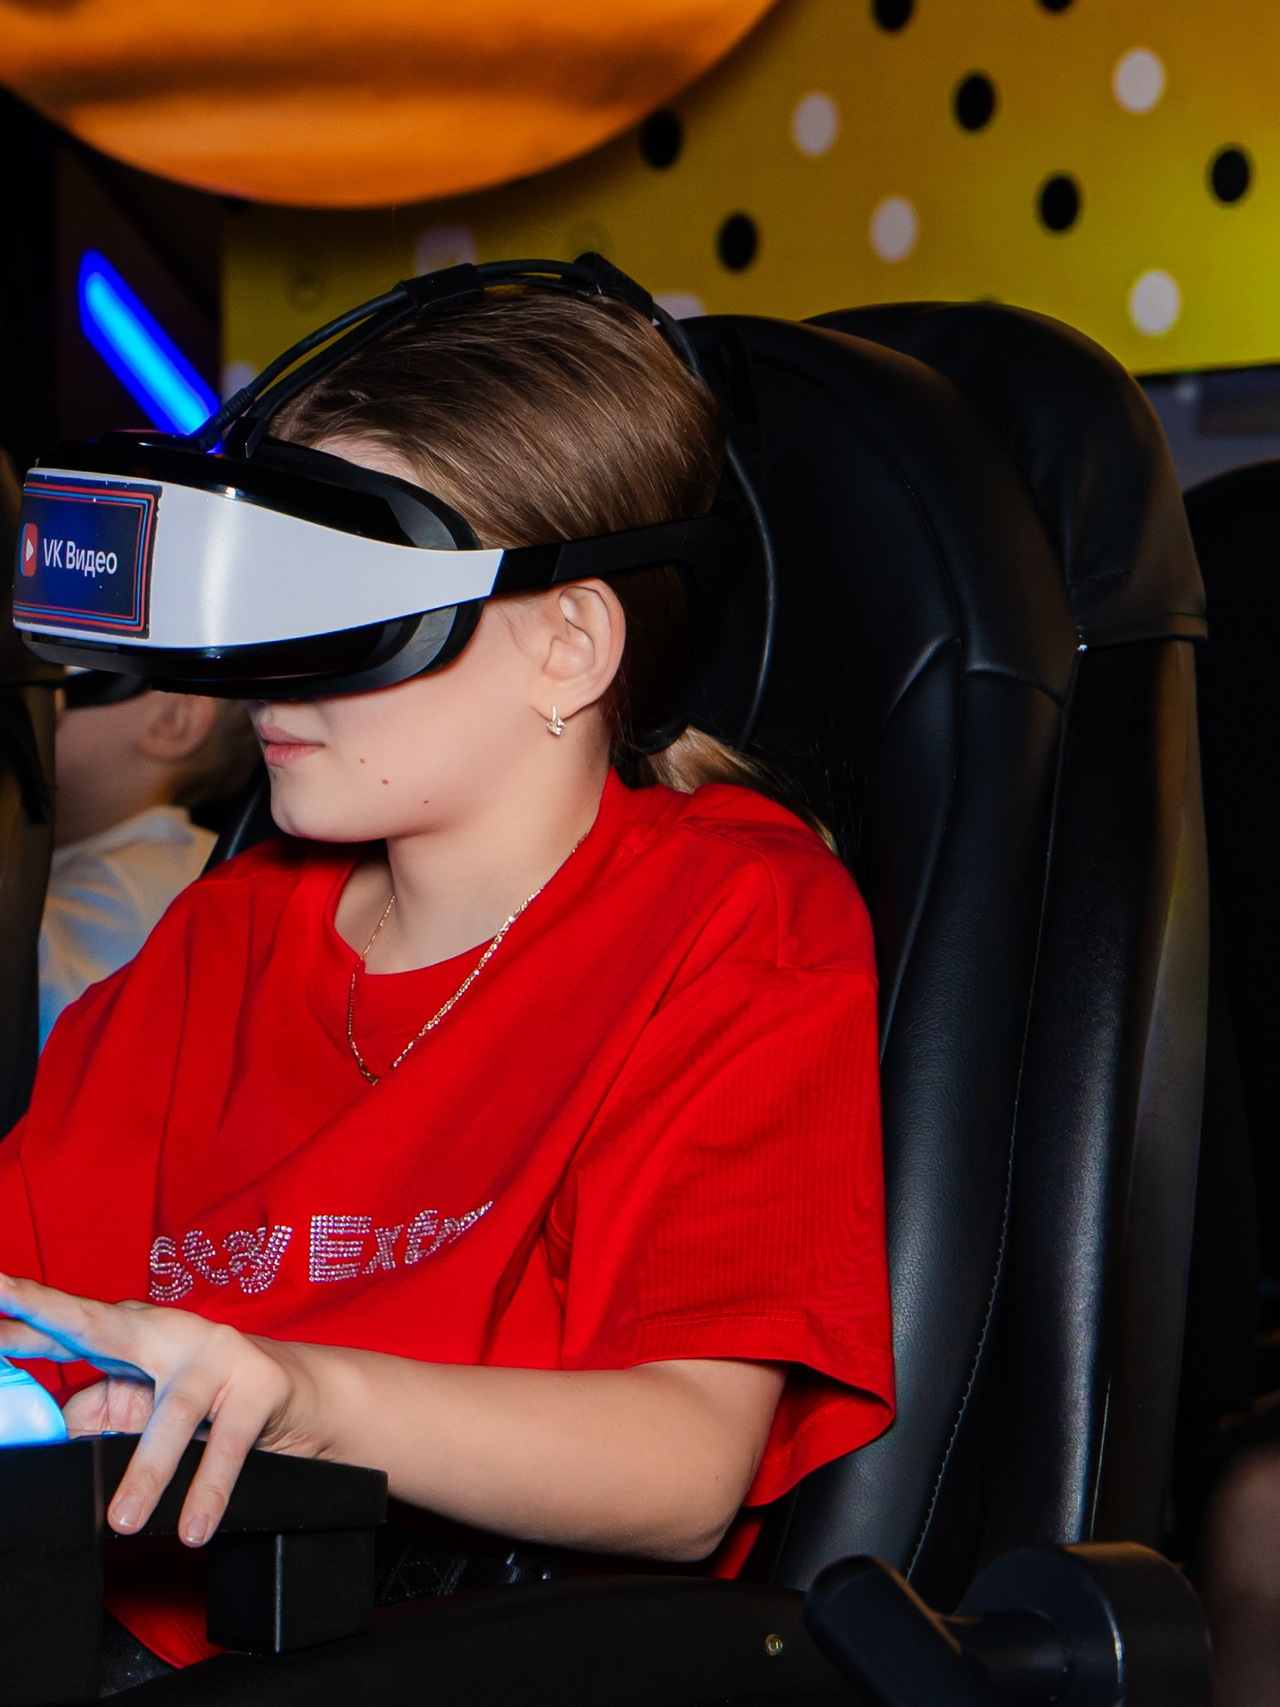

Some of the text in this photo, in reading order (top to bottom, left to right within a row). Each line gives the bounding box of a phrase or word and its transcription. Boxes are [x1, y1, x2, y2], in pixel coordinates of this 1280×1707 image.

[43, 538, 118, 578] VK Видео
[149, 1225, 294, 1303] Stay
